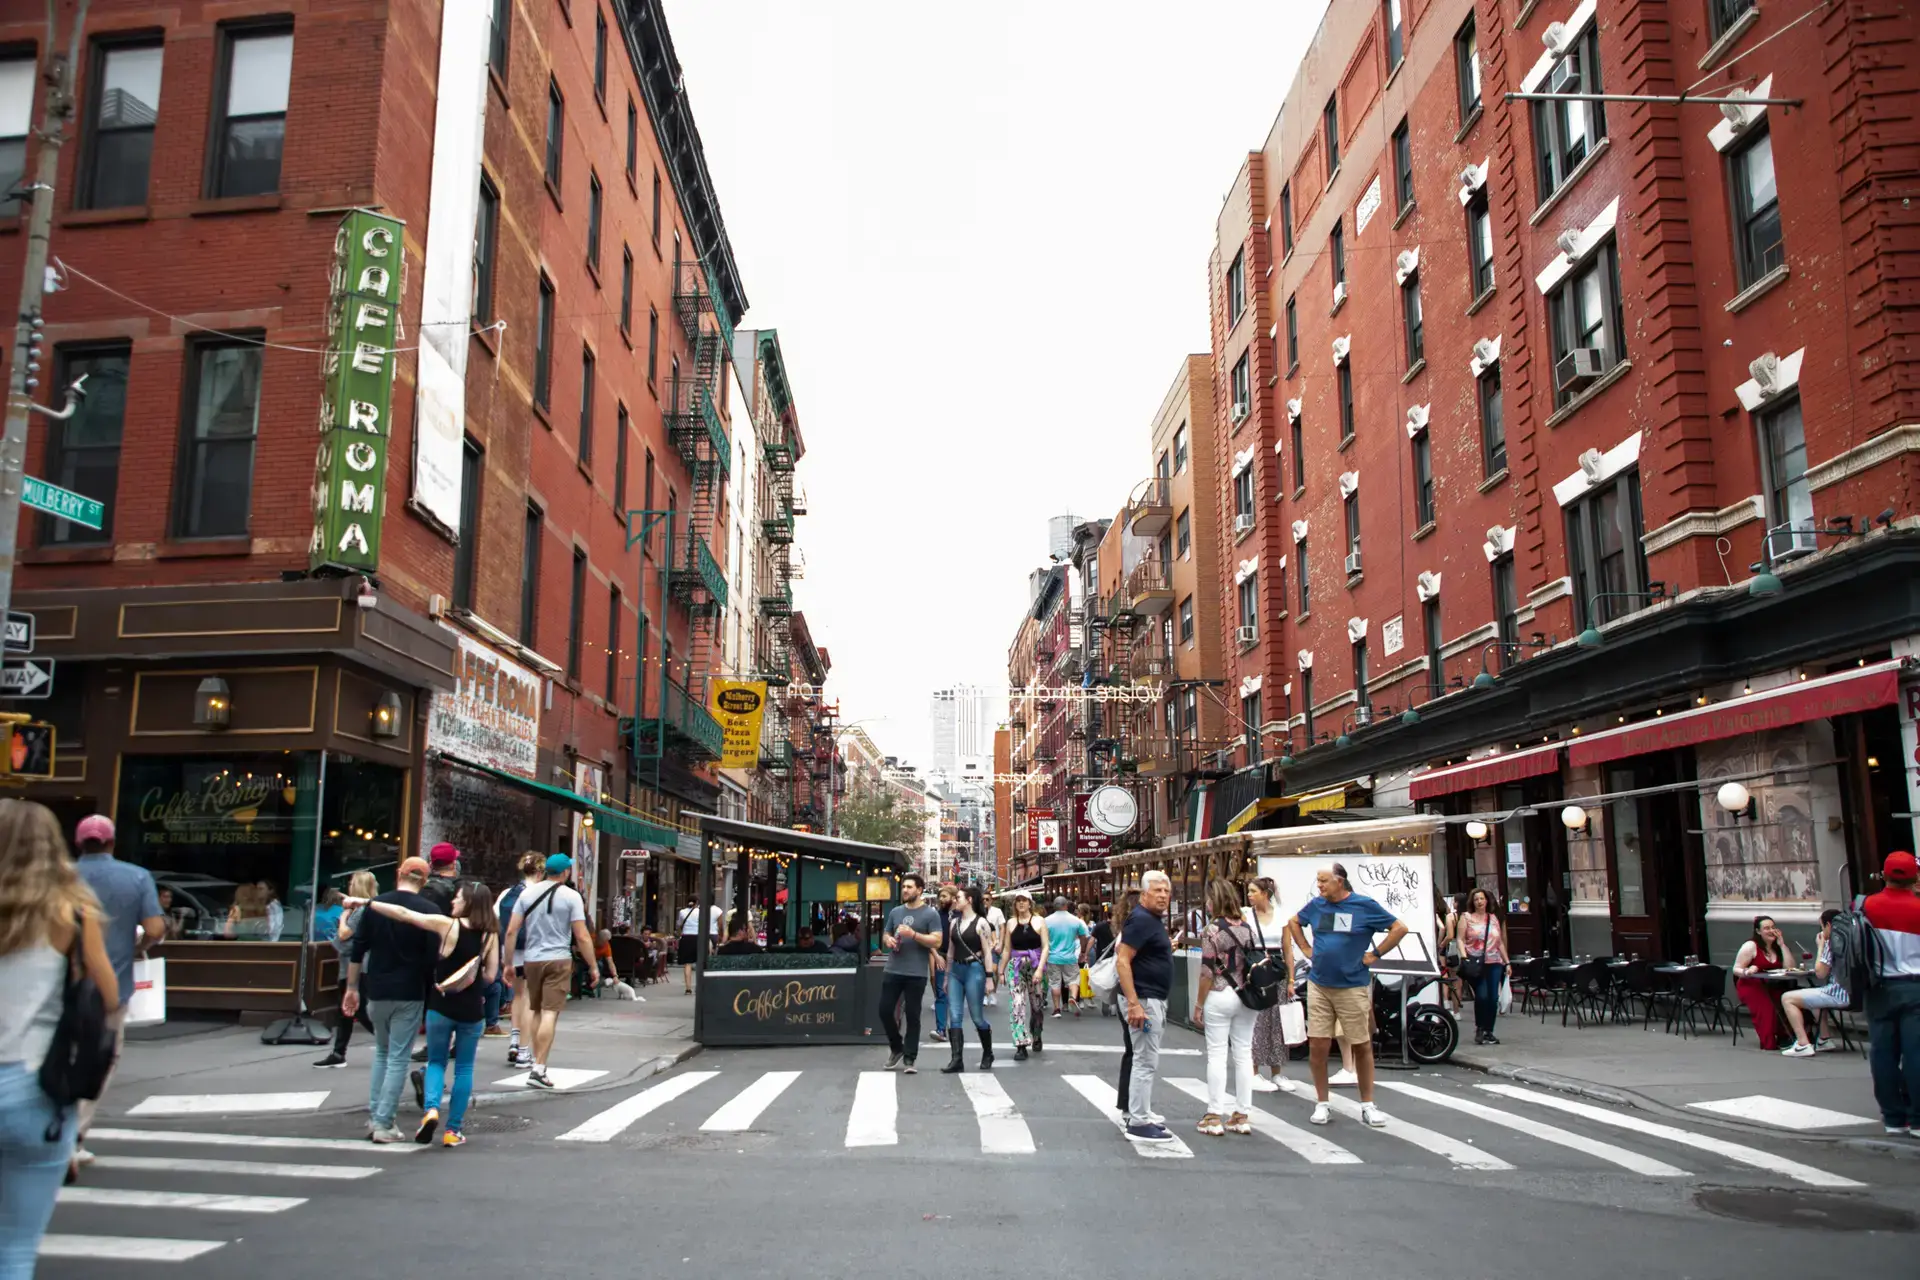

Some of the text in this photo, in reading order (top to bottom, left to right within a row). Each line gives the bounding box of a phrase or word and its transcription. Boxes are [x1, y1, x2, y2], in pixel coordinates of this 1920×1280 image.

[352, 226, 393, 375] CAFE
[338, 399, 380, 555] ROMA
[22, 479, 100, 518] MULBERRY ST
[7, 623, 24, 639] AY
[5, 669, 38, 685] WAY
[725, 691, 755, 702] Mulberry
[723, 701, 755, 710] Street Bar
[724, 728, 750, 736] Pizza
[723, 737, 750, 746] Pasta
[722, 748, 755, 757] urgers
[202, 773, 270, 815] Roma
[169, 832, 208, 844] ITALIAN
[210, 832, 260, 844] PASTRIES
[785, 981, 837, 1009] Roma
[785, 1012, 835, 1025] SINCE 1891
